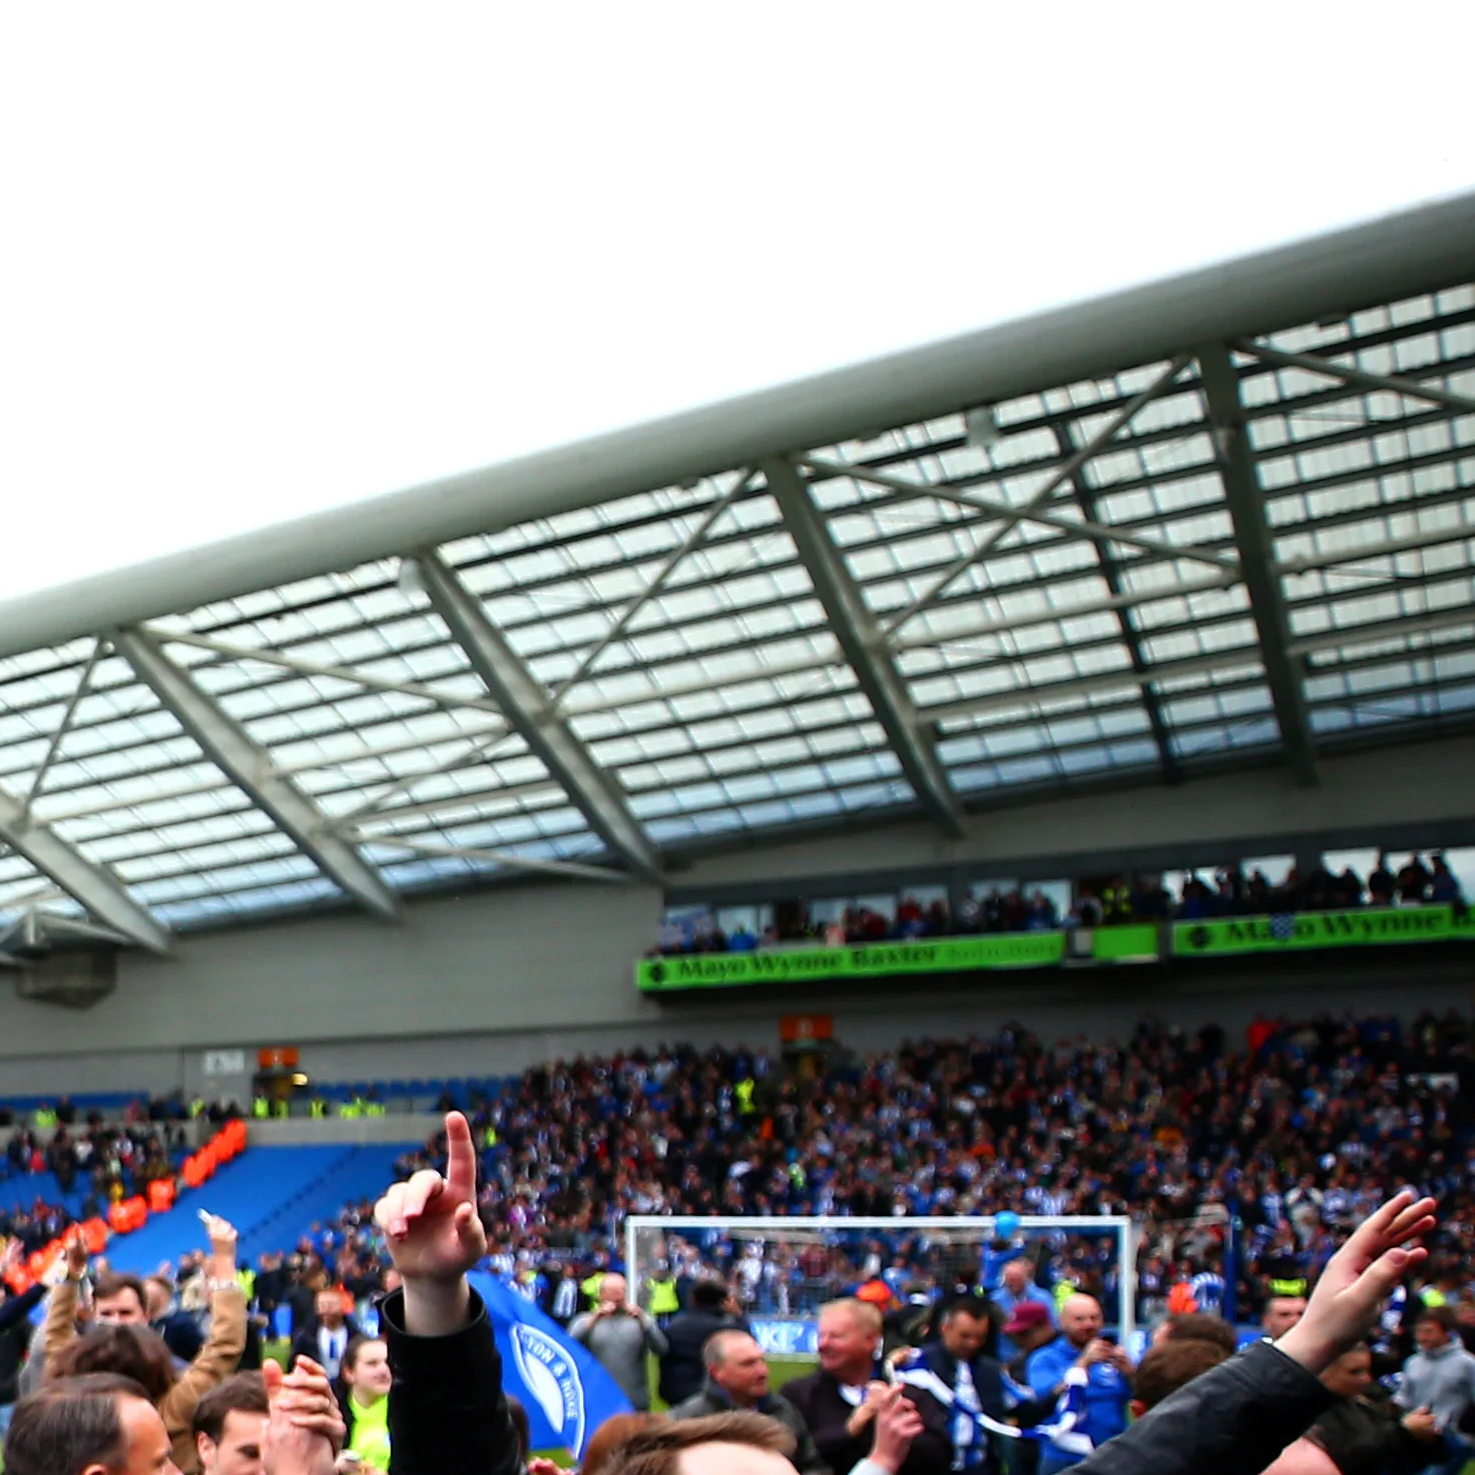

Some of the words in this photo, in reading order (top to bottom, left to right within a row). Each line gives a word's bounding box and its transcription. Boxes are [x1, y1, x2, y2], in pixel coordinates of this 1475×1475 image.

[1226, 919, 1315, 943] Mao
[1322, 912, 1444, 937] Wynne
[679, 958, 747, 984] Mayo
[751, 951, 844, 980] Wynne
[852, 947, 938, 970] Baxter
